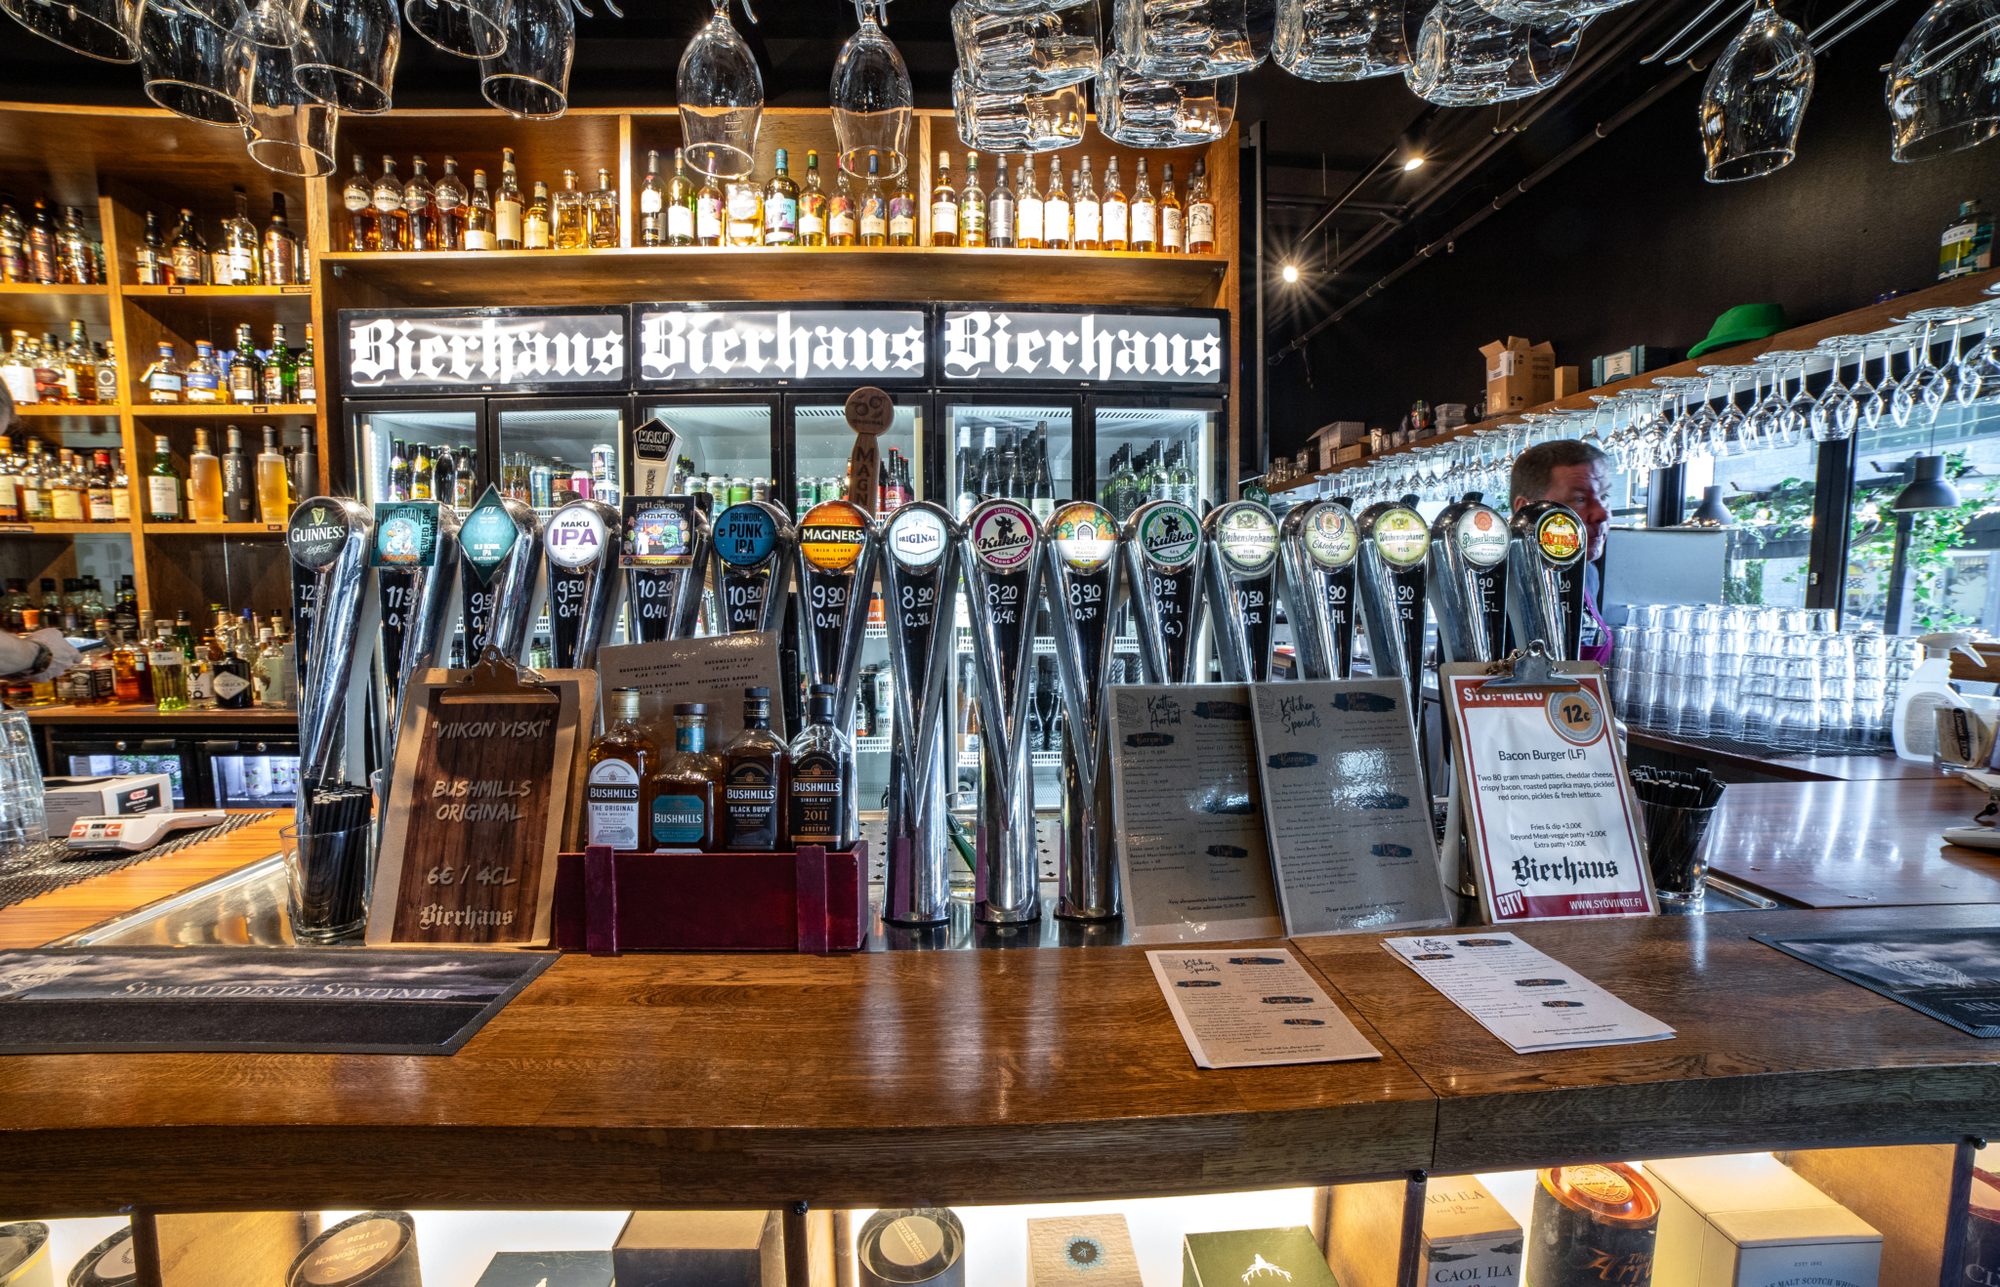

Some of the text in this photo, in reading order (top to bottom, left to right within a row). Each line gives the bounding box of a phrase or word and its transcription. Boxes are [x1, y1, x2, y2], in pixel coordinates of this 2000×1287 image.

[350, 318, 623, 387] Bierhaus
[641, 311, 924, 380] Bierhaus
[945, 311, 1220, 380] Bierhaus
[638, 430, 671, 444] MAKU
[381, 508, 422, 525] WINGMAN
[291, 525, 345, 543] GUINNESS
[420, 508, 431, 563] BREWED FOR
[428, 516, 438, 554] THE BOLD
[552, 528, 598, 546] IPA
[729, 523, 763, 538] PUNK
[802, 528, 863, 541] MAGNERS
[1219, 530, 1278, 544] Weihenstephaner
[735, 539, 755, 554] IPA
[978, 533, 1031, 550] Kukko
[1145, 531, 1195, 548] Kukko
[1311, 540, 1351, 551] Oktoberfest
[1279, 696, 1316, 714] Kitchen
[1281, 713, 1322, 736] Specials
[1498, 748, 1587, 764] Bacon Burger (LF)
[1493, 773, 1502, 781] 80
[1566, 771, 1591, 779] cheddar
[432, 780, 534, 799] BUSHMILLS
[590, 787, 638, 799] BUSHMILLS
[726, 788, 776, 800] BUSHMILLS
[793, 781, 841, 792] BUSHMILLS
[1481, 784, 1500, 792] crispy
[1548, 782, 1572, 791] paprika
[1531, 792, 1554, 800] pickles
[1561, 791, 1578, 799] fresh
[436, 803, 524, 823] ORIGINAL
[604, 804, 634, 812] ORIGINAL
[730, 805, 751, 813] BLACK
[804, 810, 828, 820] 2011
[654, 812, 703, 824] BUSHMILLS
[1551, 823, 1561, 831] dip
[1510, 833, 1532, 841] Beyond
[1569, 831, 1585, 839] patty
[426, 864, 518, 887] 6€ / 4CL
[1511, 855, 1619, 887] Bierhaus
[1496, 891, 1525, 916] CITY
[1569, 897, 1643, 910] WWW.SYÖVIIKOT.FI
[418, 902, 514, 931] Bierhaus
[314, 982, 450, 999] SYNTYNYT
[1457, 1189, 1486, 1201] ILA
[1434, 1264, 1514, 1283] CAOL ILA
[1777, 1277, 1834, 1287] MALT SCOTCH
